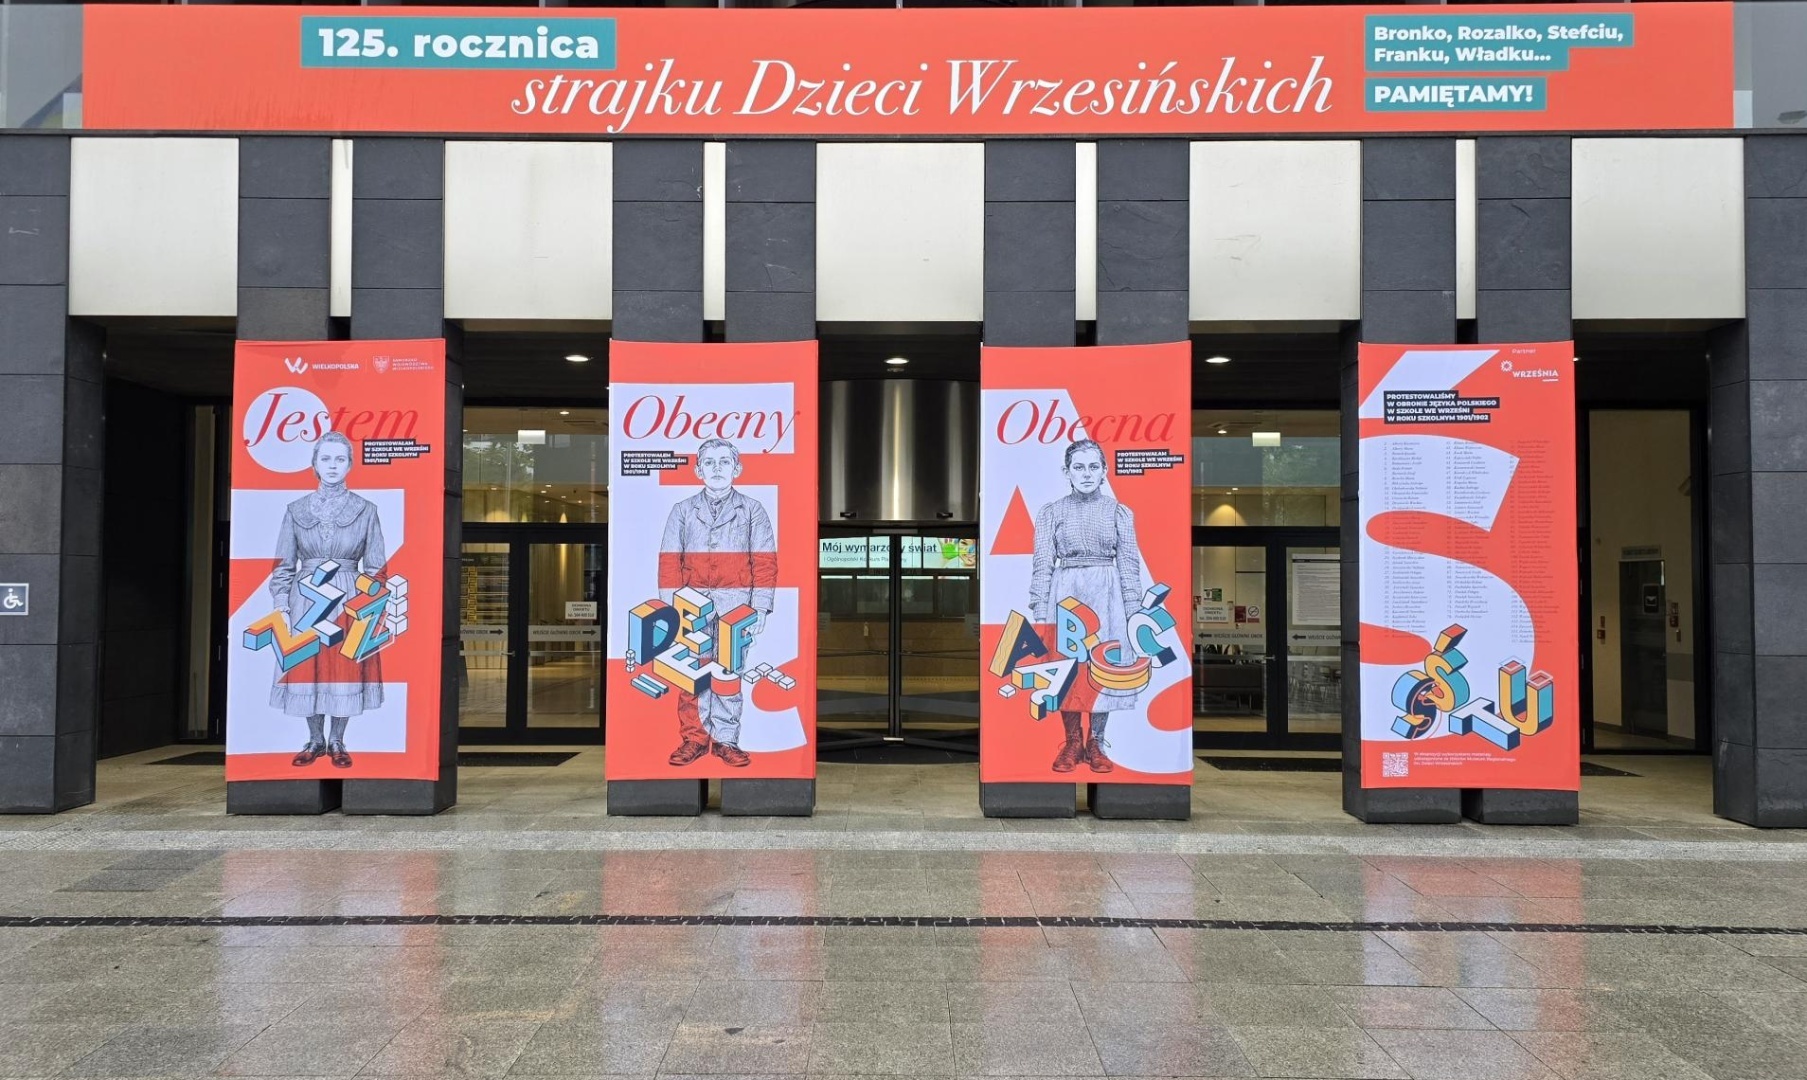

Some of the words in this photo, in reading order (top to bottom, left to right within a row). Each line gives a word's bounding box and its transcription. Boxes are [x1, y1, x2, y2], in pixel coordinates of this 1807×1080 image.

[319, 28, 398, 58] 125.
[414, 26, 599, 59] rocznica
[1374, 26, 1453, 43] Bronko,
[1458, 26, 1543, 42] Rozalko,
[1547, 24, 1623, 42] Stefciu,
[1374, 48, 1450, 64] Franku,
[1455, 47, 1551, 61] Władku...
[511, 58, 722, 134] strajku
[733, 59, 928, 117] Dzieci
[946, 56, 1333, 116] Wrzesińskich
[1374, 85, 1533, 108] PAMIĘTAMY!
[1512, 369, 1559, 378] WRZEŚNIA
[1386, 392, 1456, 400] PROTESTOWALIŚMY
[1429, 400, 1456, 408] JĘZYKA
[244, 393, 419, 448] Jestem
[622, 395, 801, 454] Obecny
[996, 399, 1176, 445] Obecna
[822, 542, 842, 553] Mój
[844, 545, 905, 554] wymarzoy
[908, 543, 937, 553] świat
